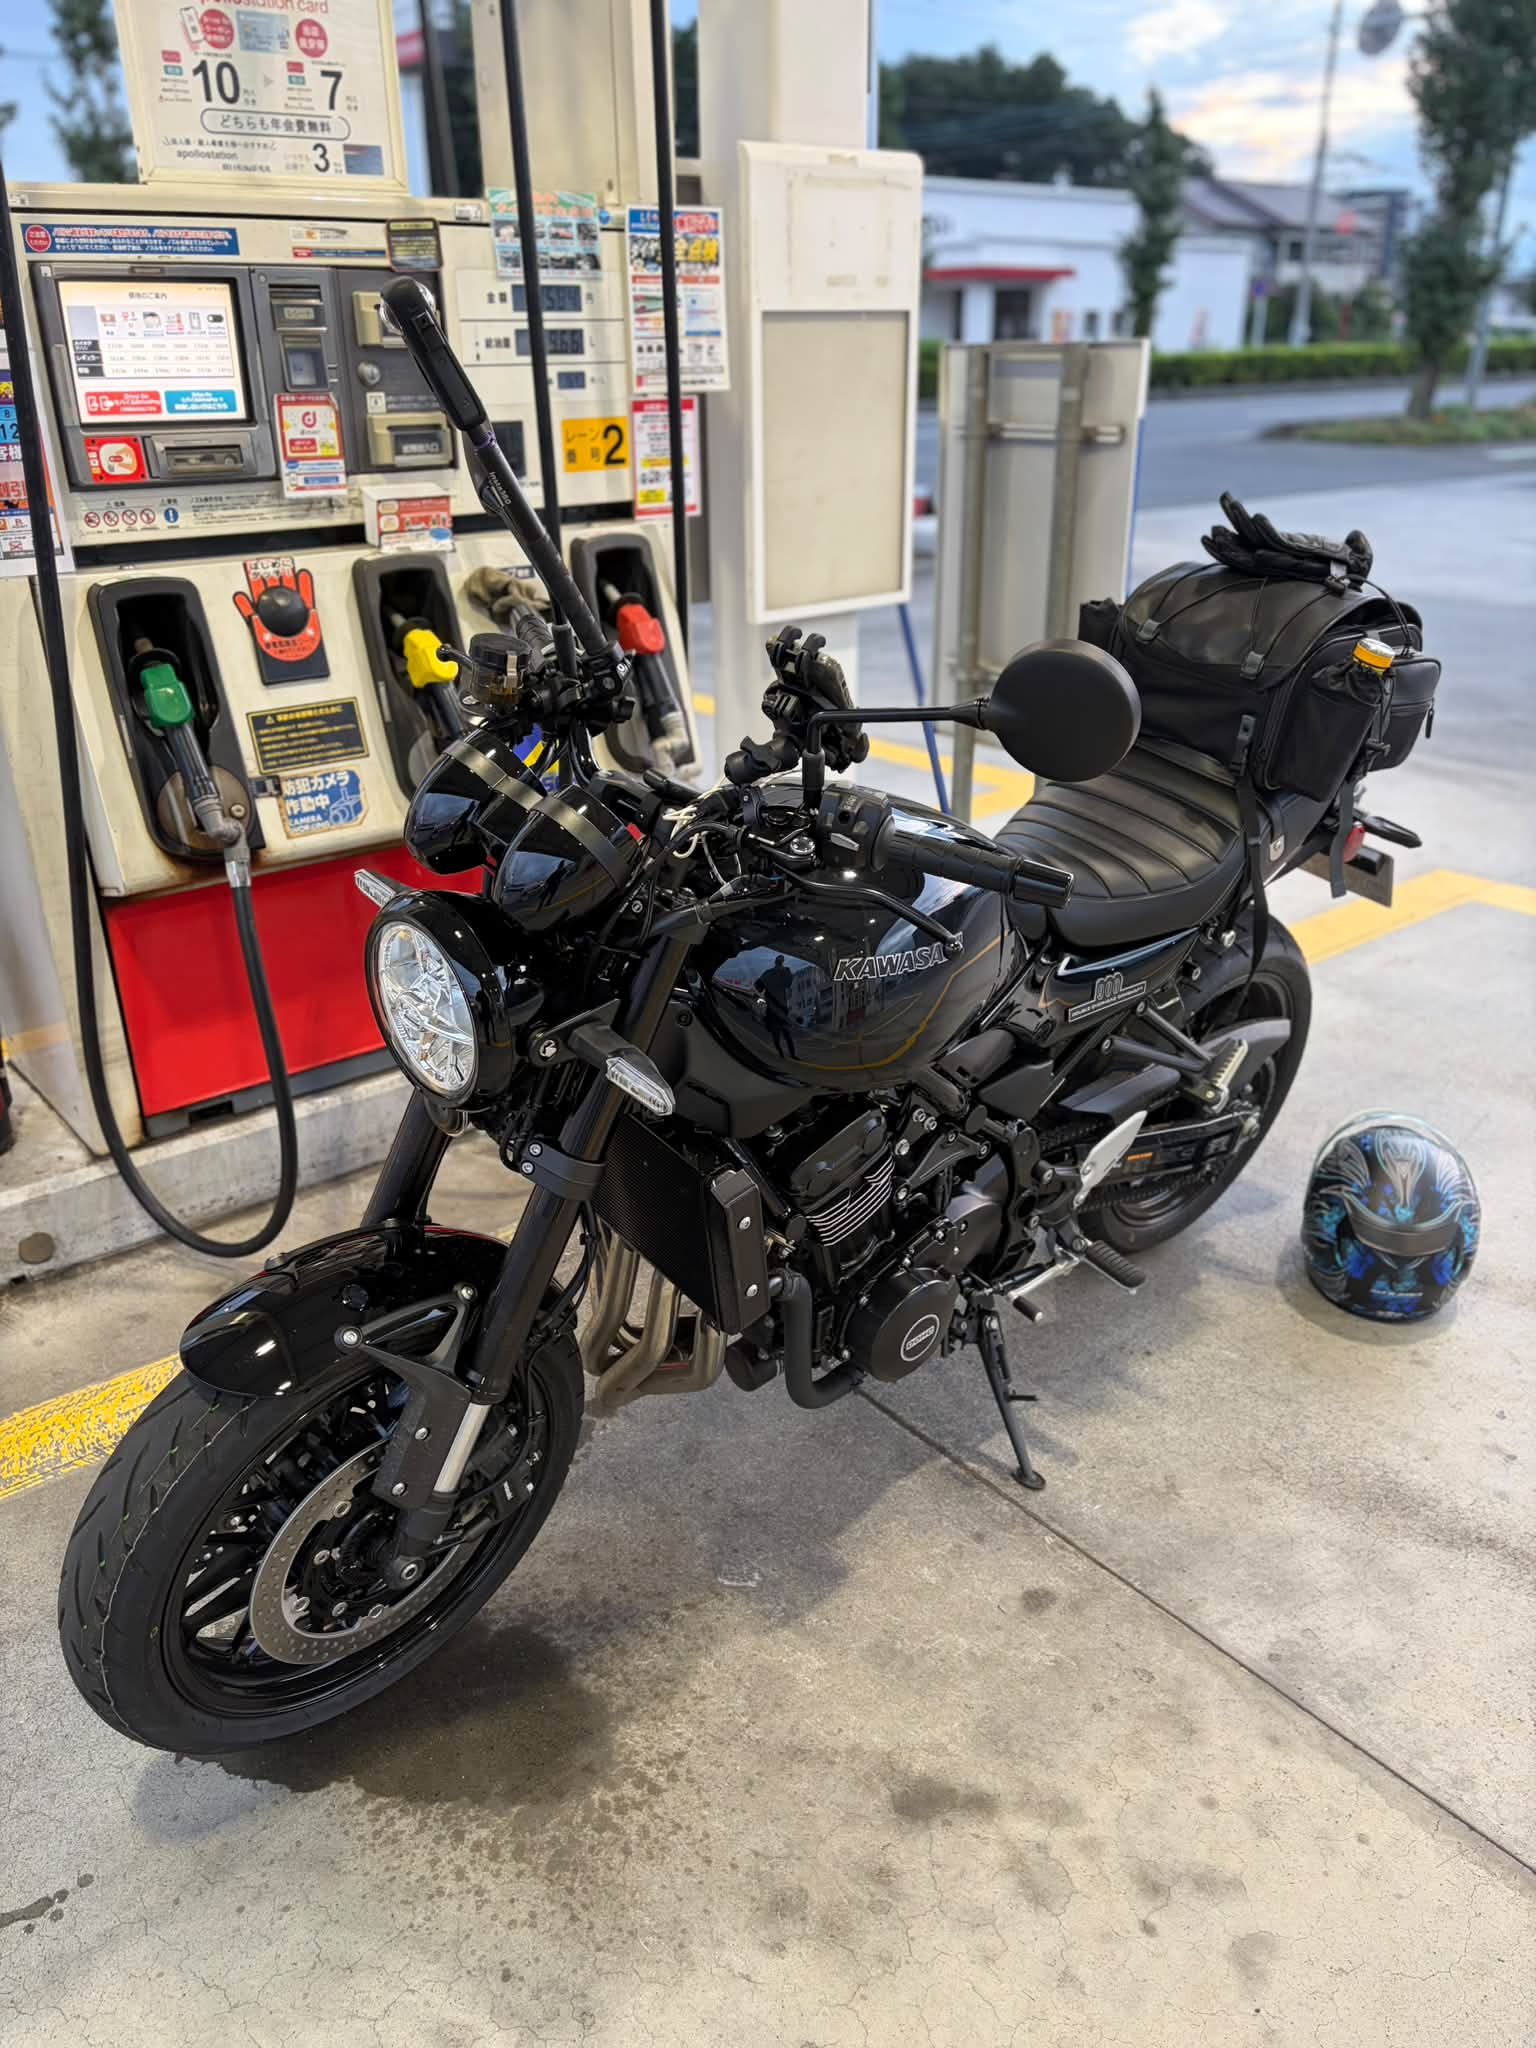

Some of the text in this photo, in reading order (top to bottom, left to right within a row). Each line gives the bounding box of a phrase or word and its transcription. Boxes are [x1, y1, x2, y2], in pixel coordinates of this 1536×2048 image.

[192, 59, 240, 104] 10
[320, 70, 343, 110] 7
[312, 143, 331, 173] 3
[603, 424, 626, 465] 2
[833, 931, 964, 981] KAWASA
